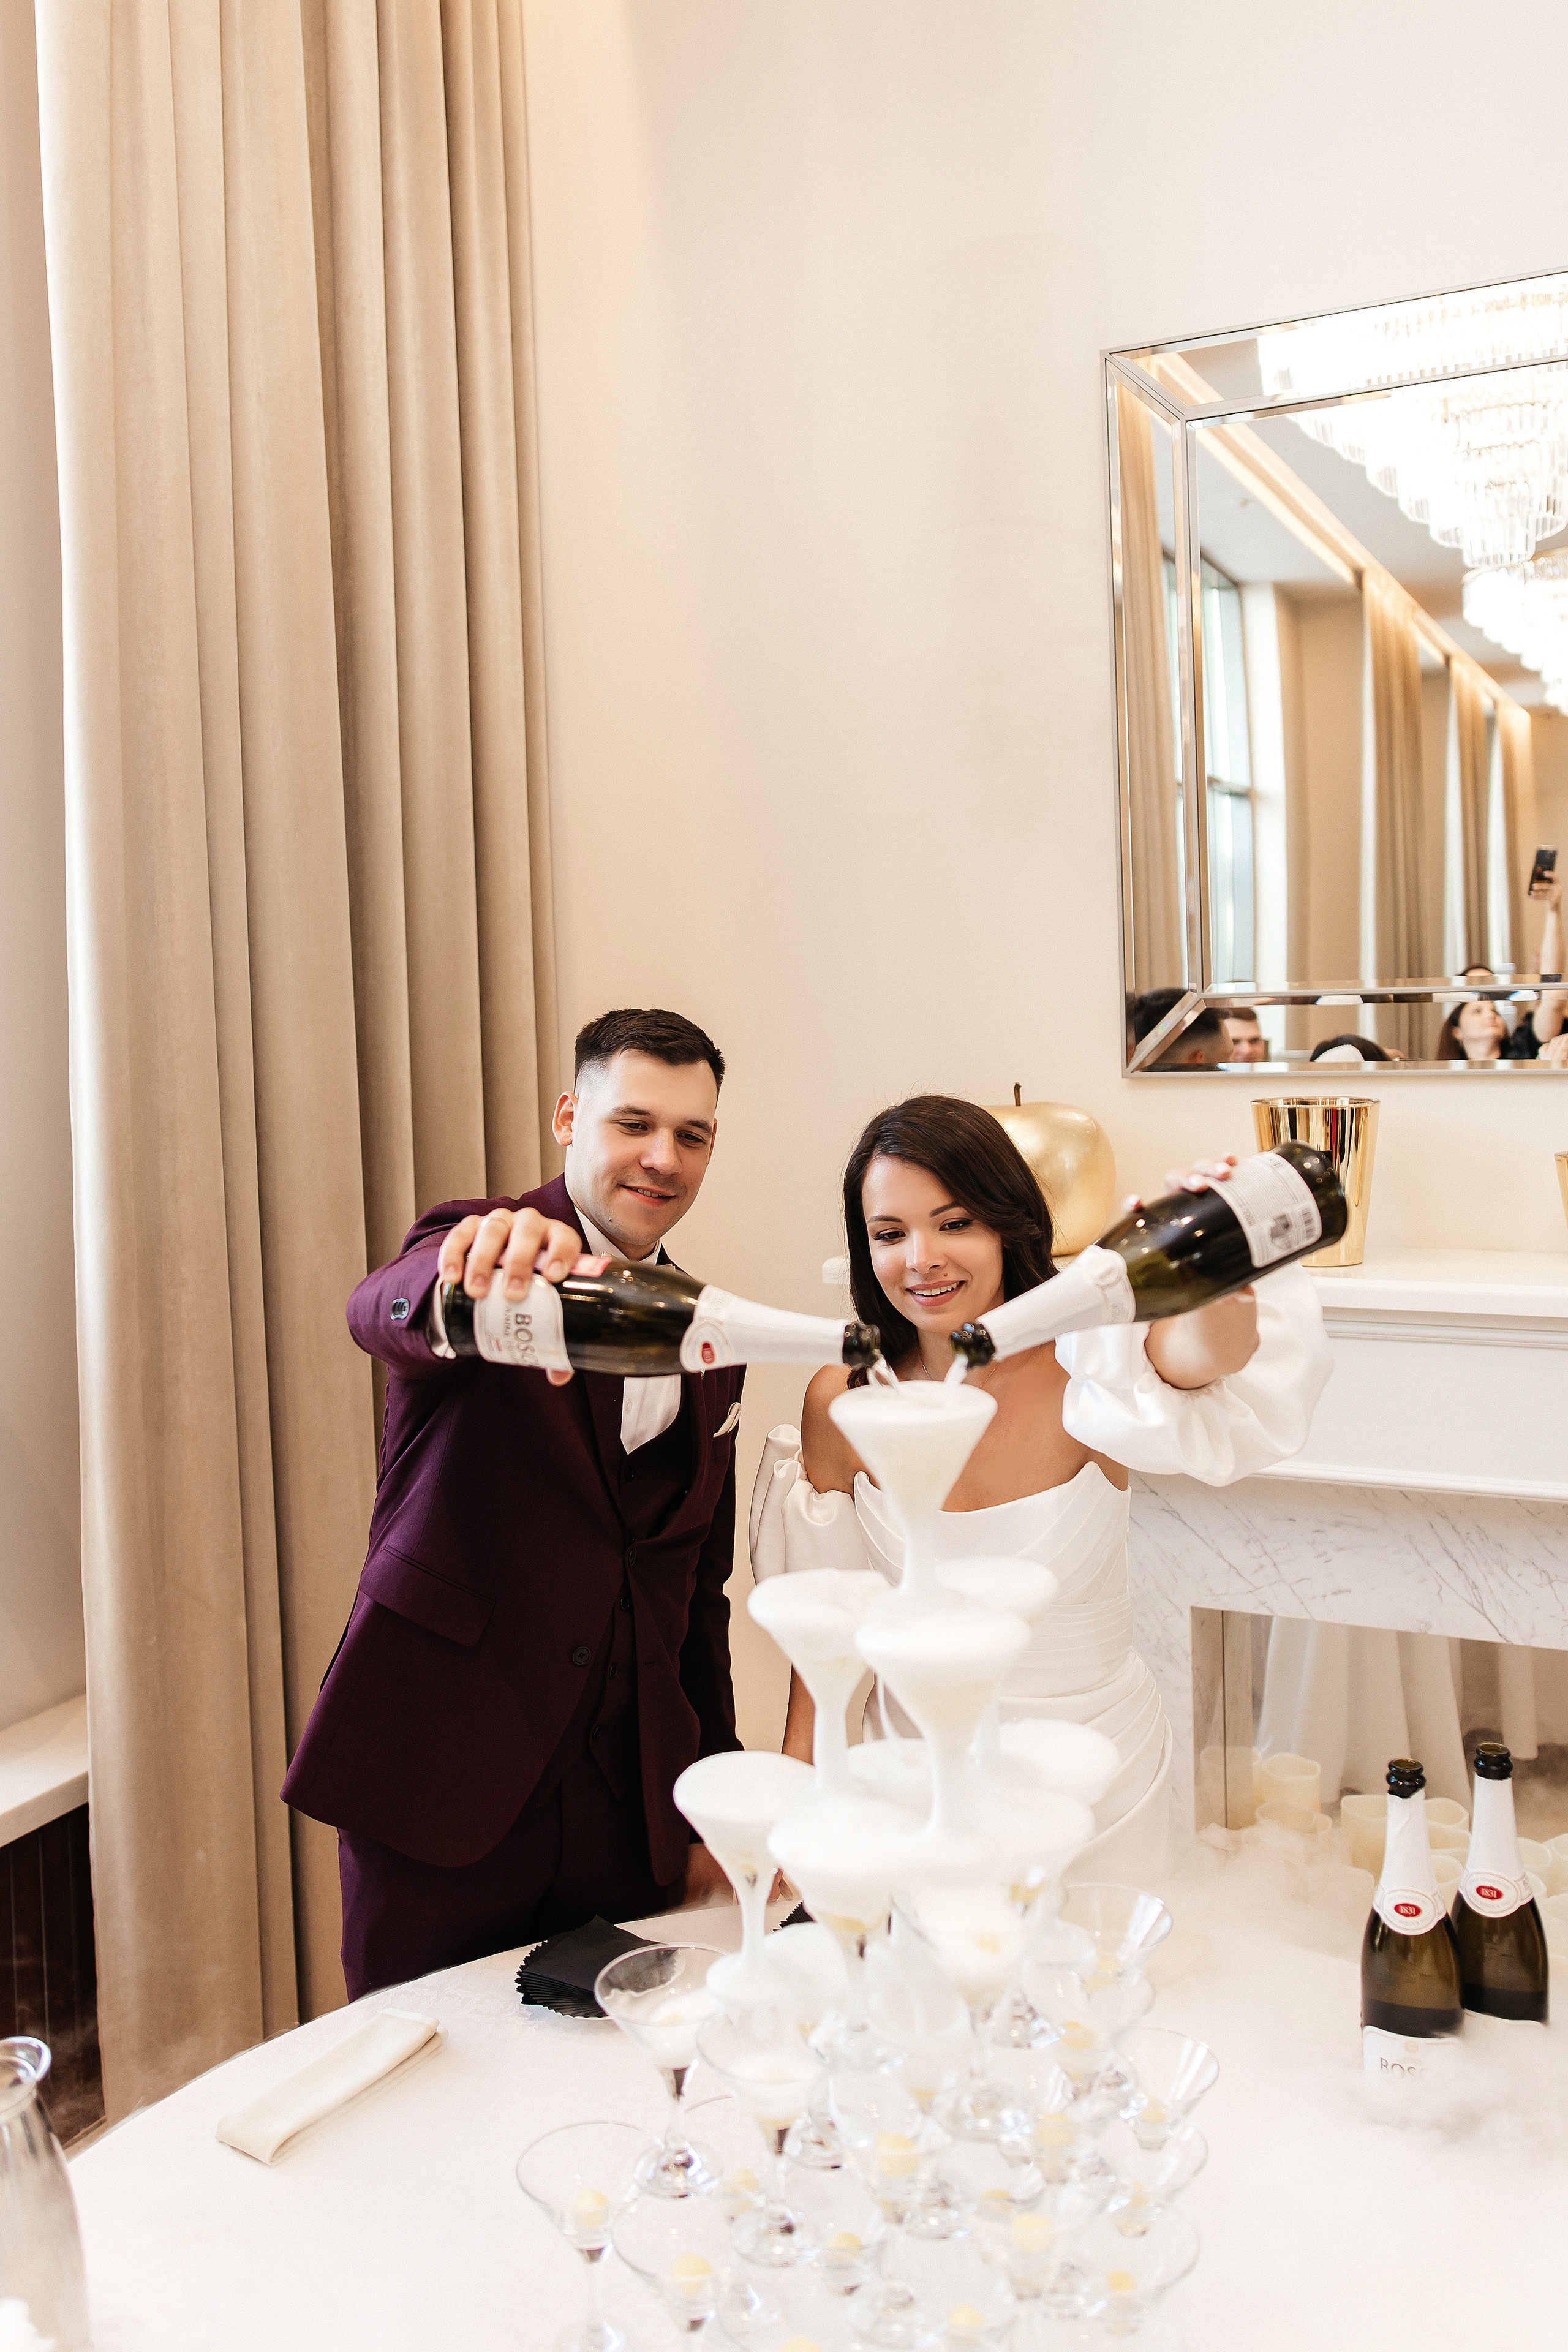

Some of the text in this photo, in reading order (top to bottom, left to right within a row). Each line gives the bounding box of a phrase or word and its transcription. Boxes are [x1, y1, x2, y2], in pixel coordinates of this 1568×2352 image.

[513, 1313, 540, 1365] BOSC
[1480, 1887, 1497, 1898] 1831
[1398, 1905, 1416, 1915] 1831
[1380, 2057, 1425, 2080] BOS
